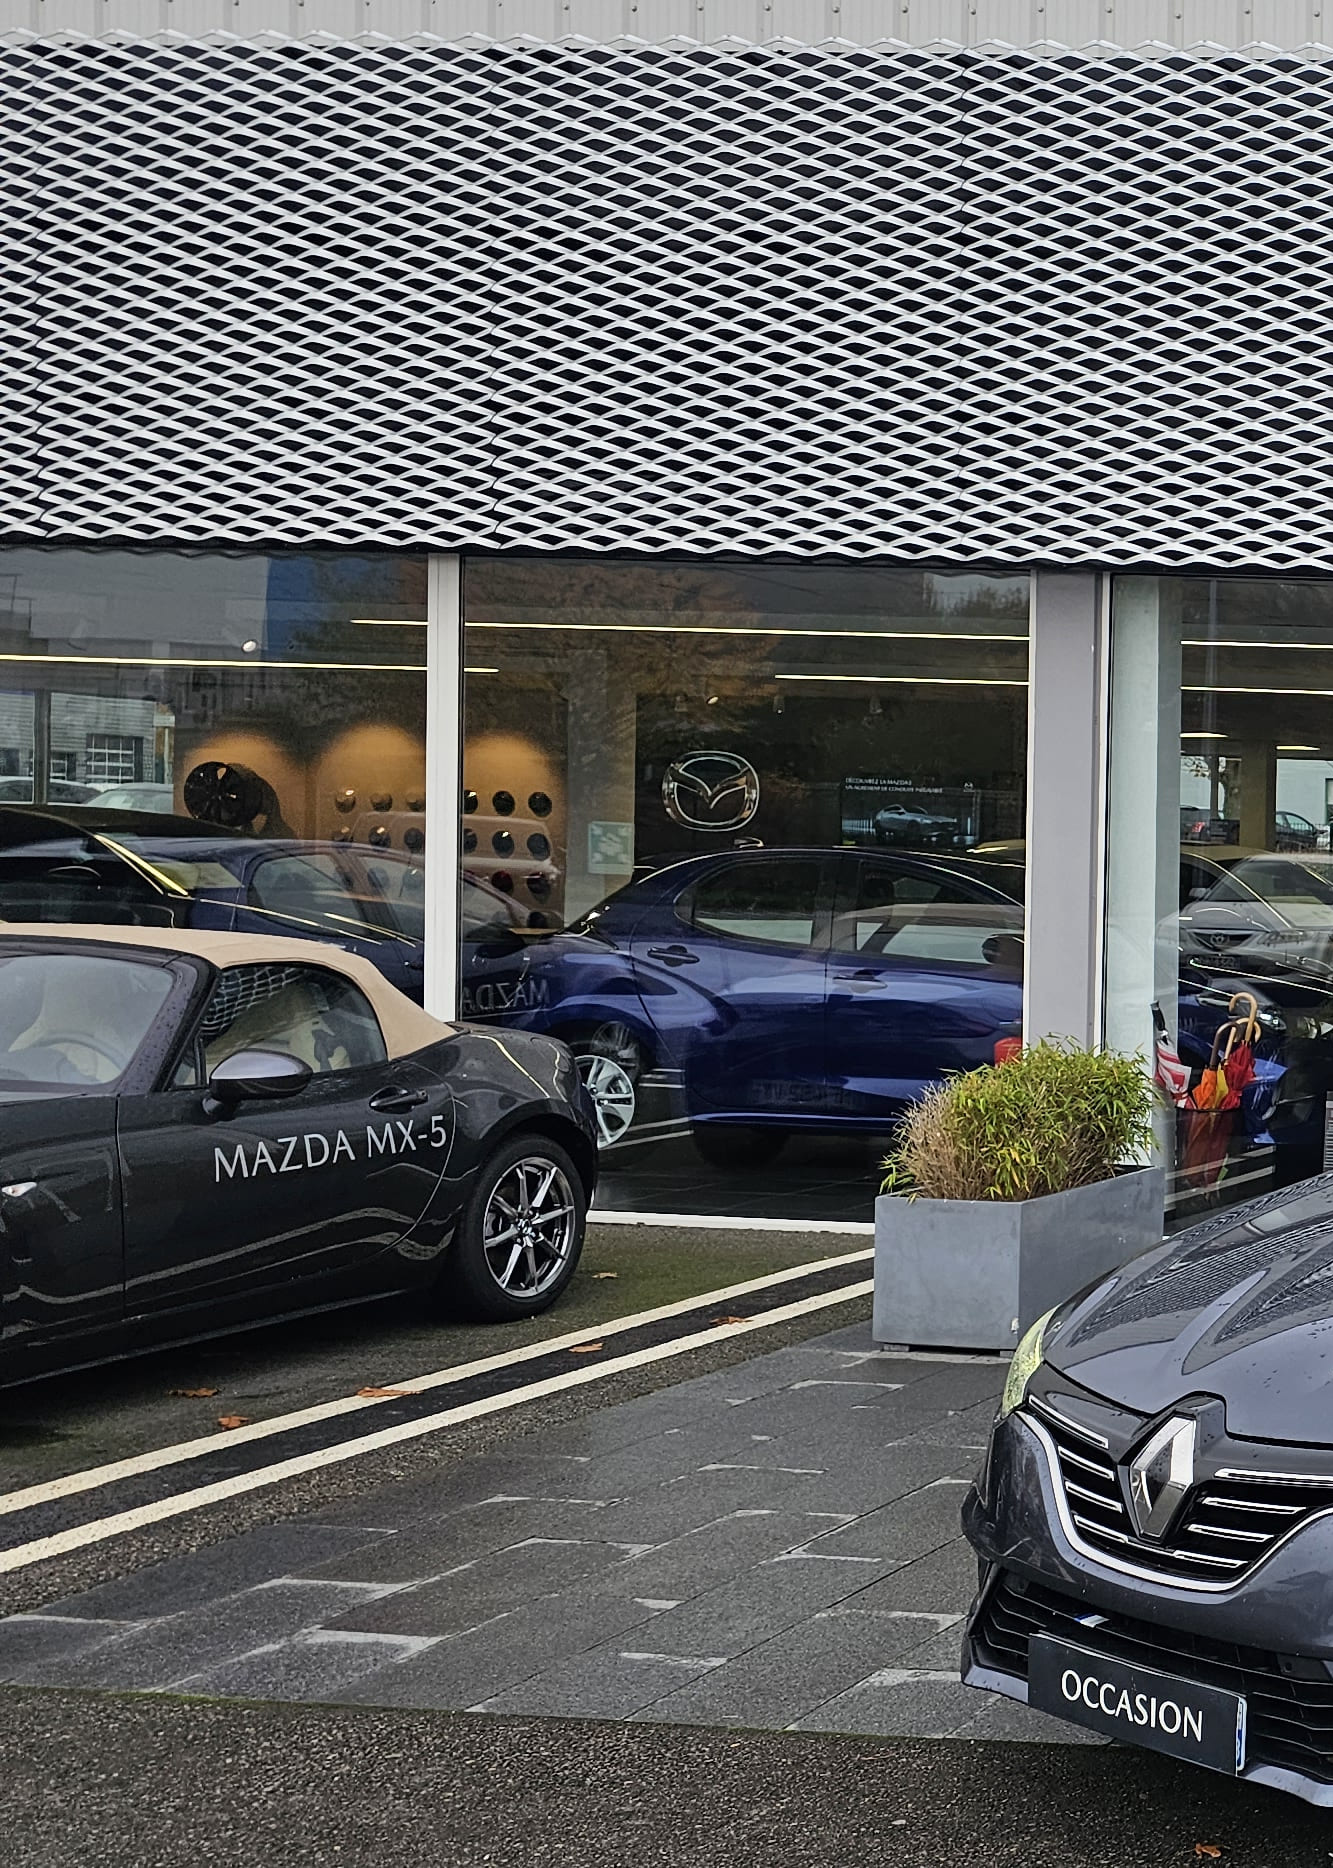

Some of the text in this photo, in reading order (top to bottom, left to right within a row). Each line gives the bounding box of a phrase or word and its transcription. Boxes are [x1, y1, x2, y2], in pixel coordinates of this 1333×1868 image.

[213, 1115, 447, 1183] MAZDA MX-5
[1061, 1669, 1203, 1743] OCCASION
